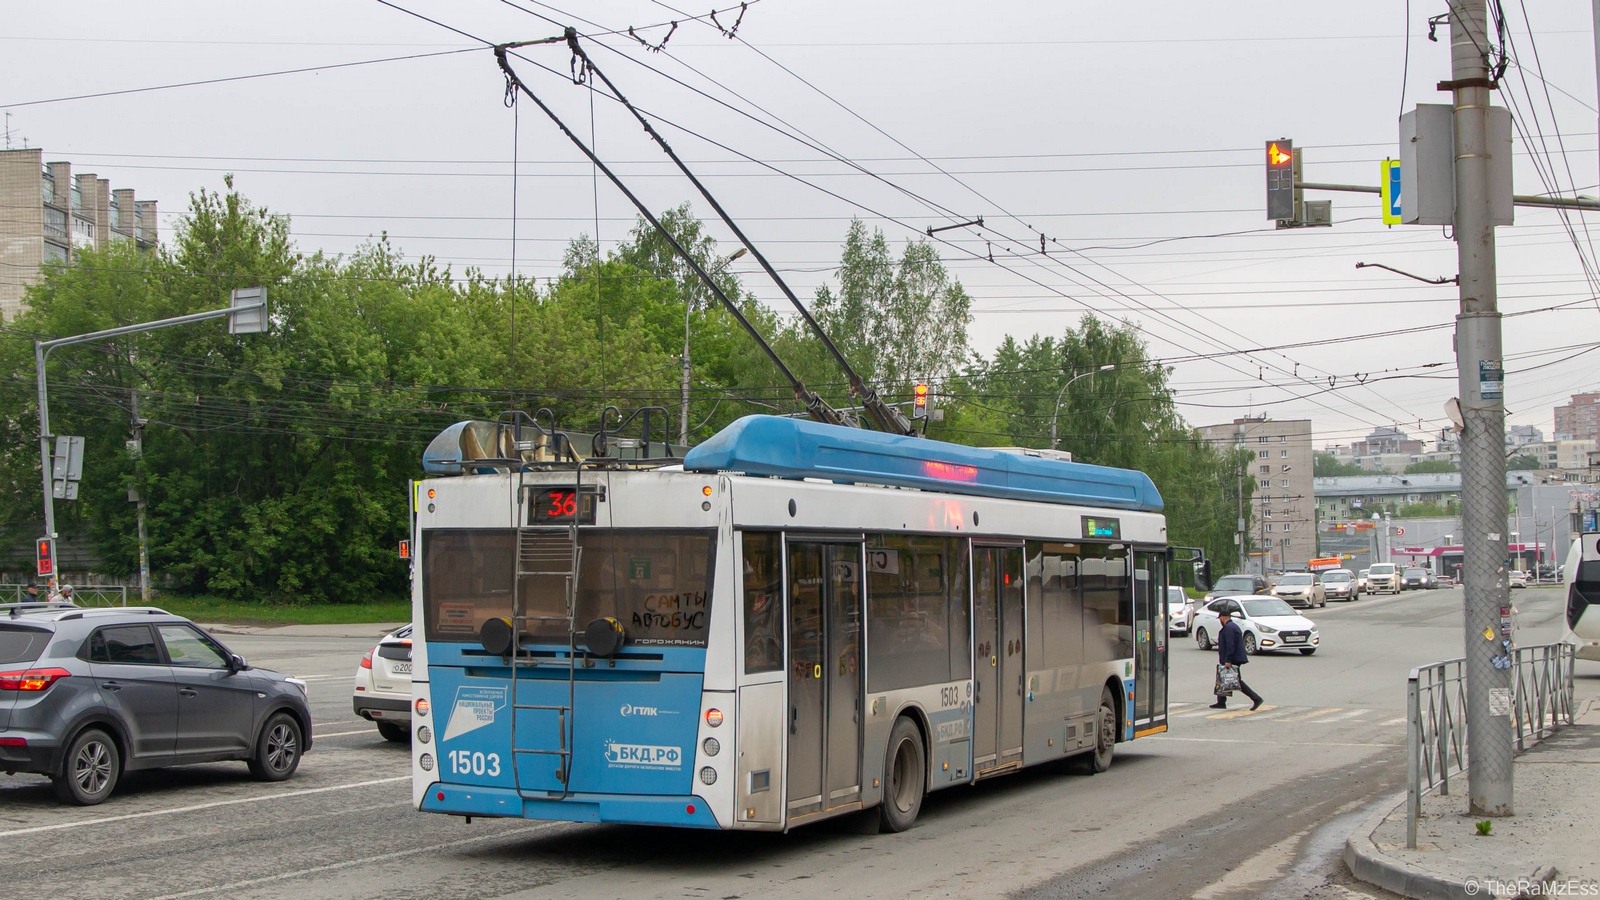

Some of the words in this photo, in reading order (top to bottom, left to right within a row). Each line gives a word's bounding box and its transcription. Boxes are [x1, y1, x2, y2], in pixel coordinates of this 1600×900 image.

[547, 492, 577, 516] 36
[644, 594, 679, 611] САМ
[684, 591, 707, 608] ТЫ
[632, 611, 704, 630] АВТОБУС
[458, 701, 493, 709] НАЦИОНАЛЬНЫЕ
[940, 685, 958, 707] 1503
[633, 706, 657, 716] ГТЛК
[448, 750, 501, 777] 1503
[620, 747, 679, 763] БКД.РФ
